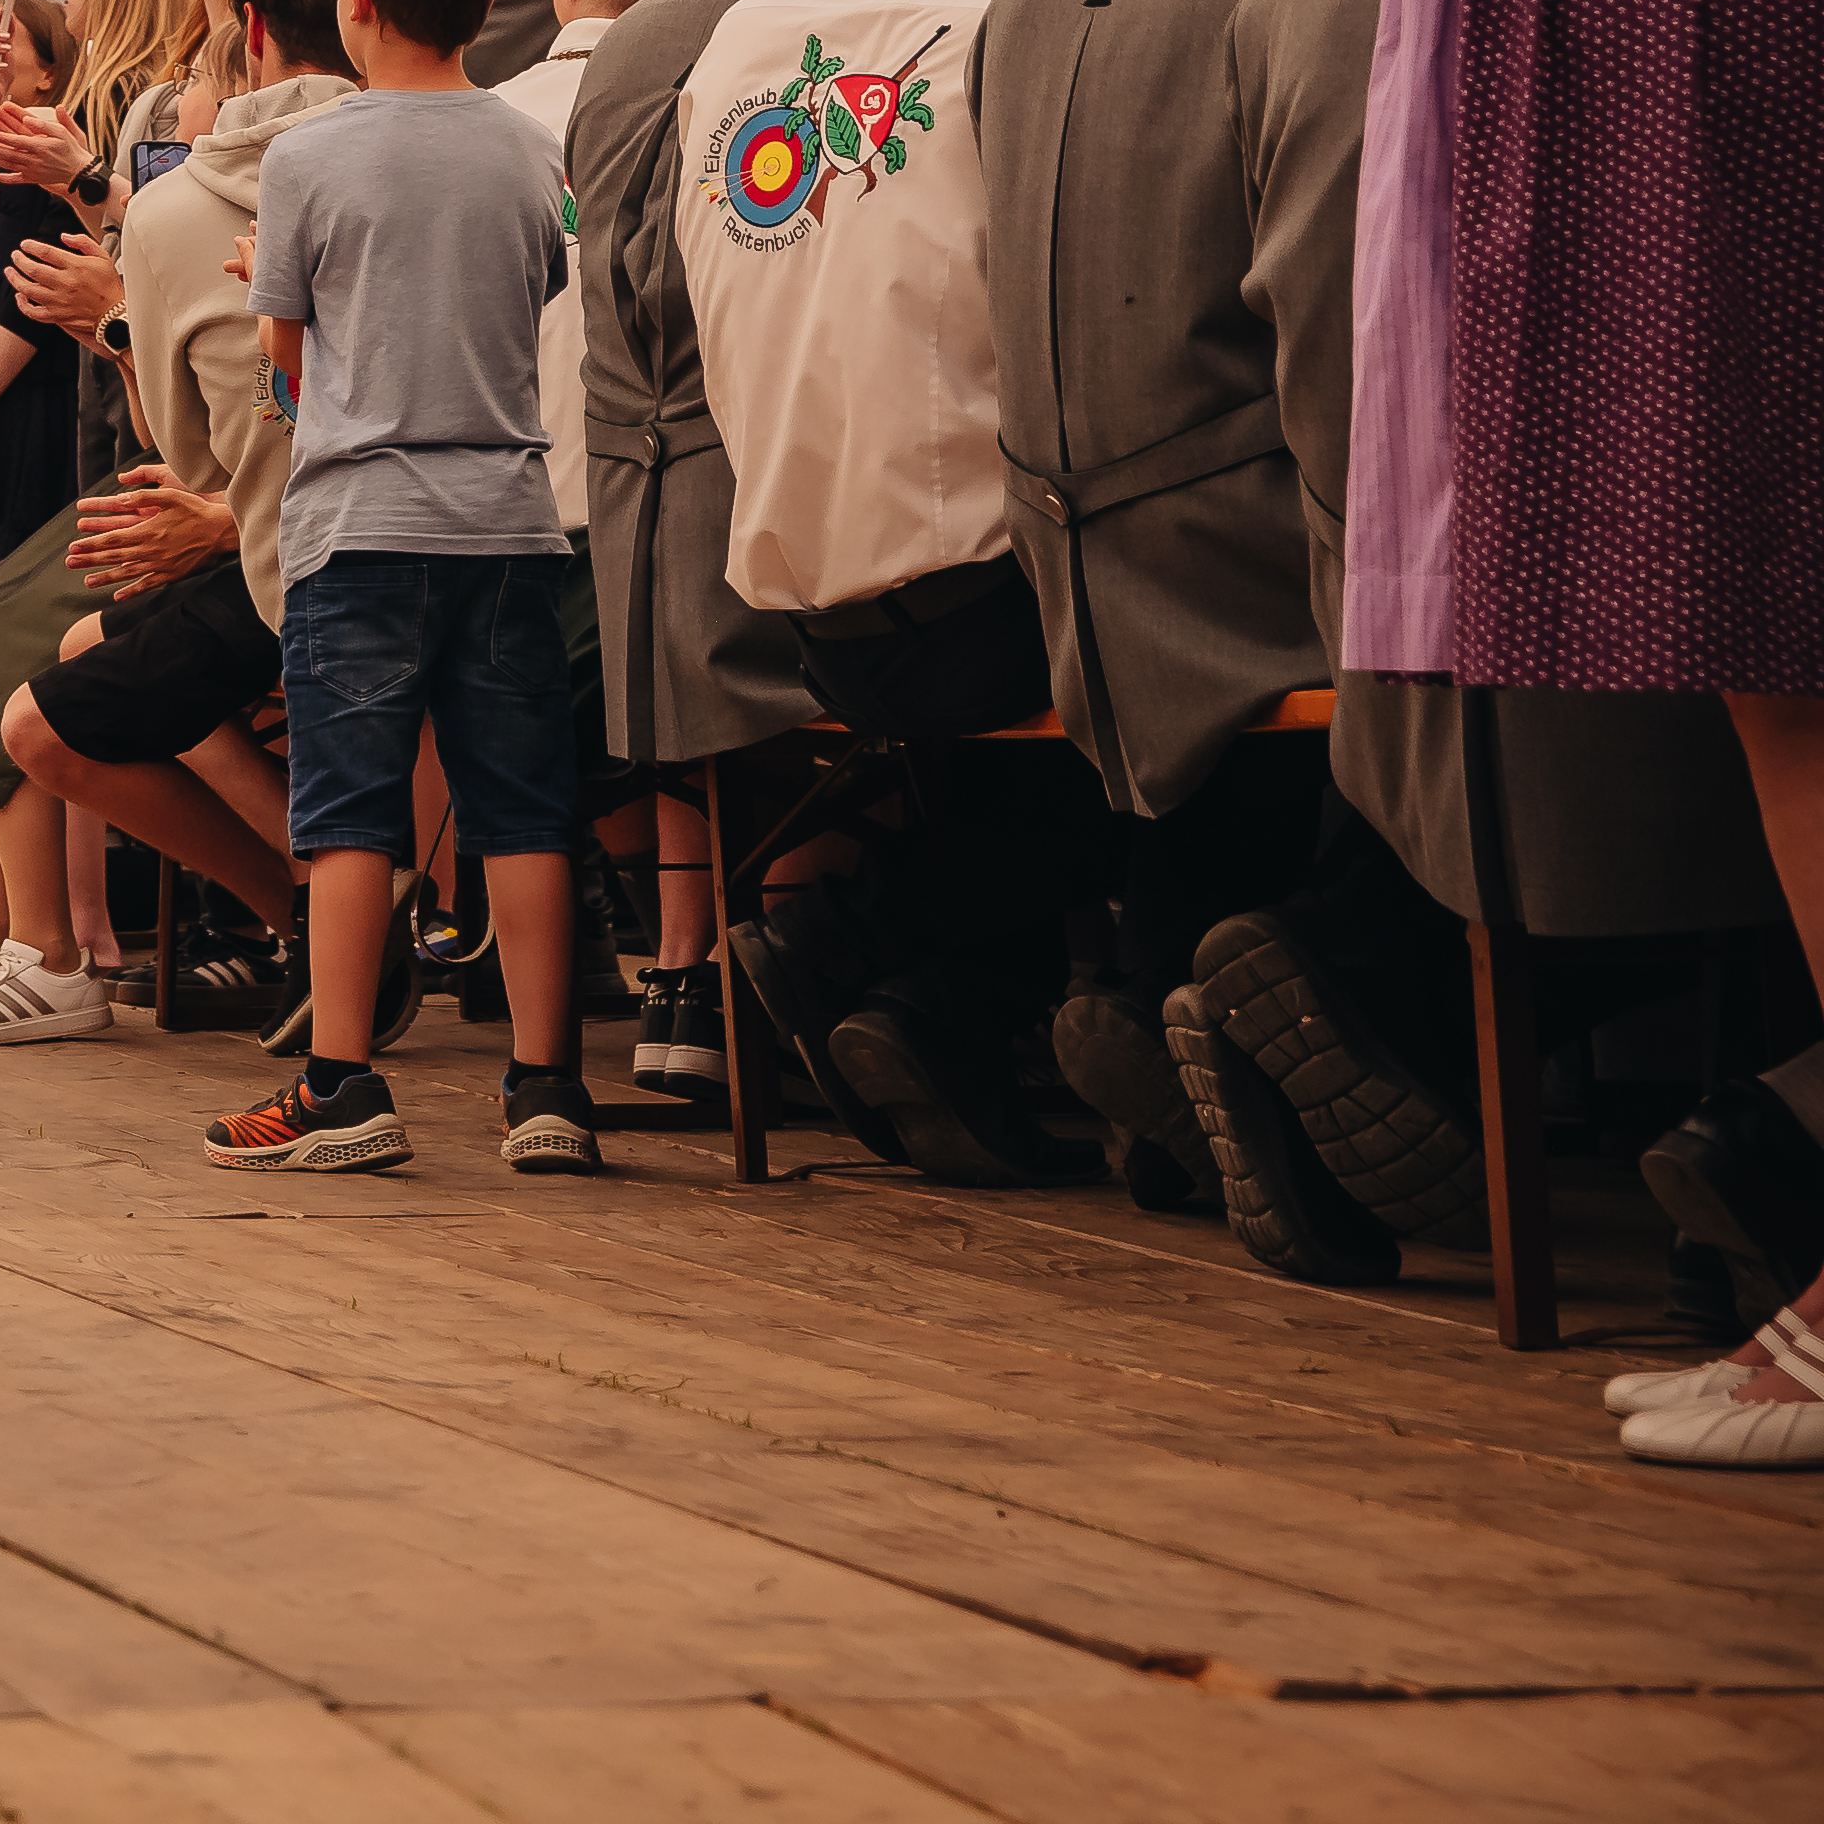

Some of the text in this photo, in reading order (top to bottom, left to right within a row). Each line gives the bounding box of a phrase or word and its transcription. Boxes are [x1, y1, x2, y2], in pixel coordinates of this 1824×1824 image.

[704, 88, 778, 174] Eichenlaub
[722, 216, 813, 254] Raitenbuch
[254, 353, 271, 400] Eiche
